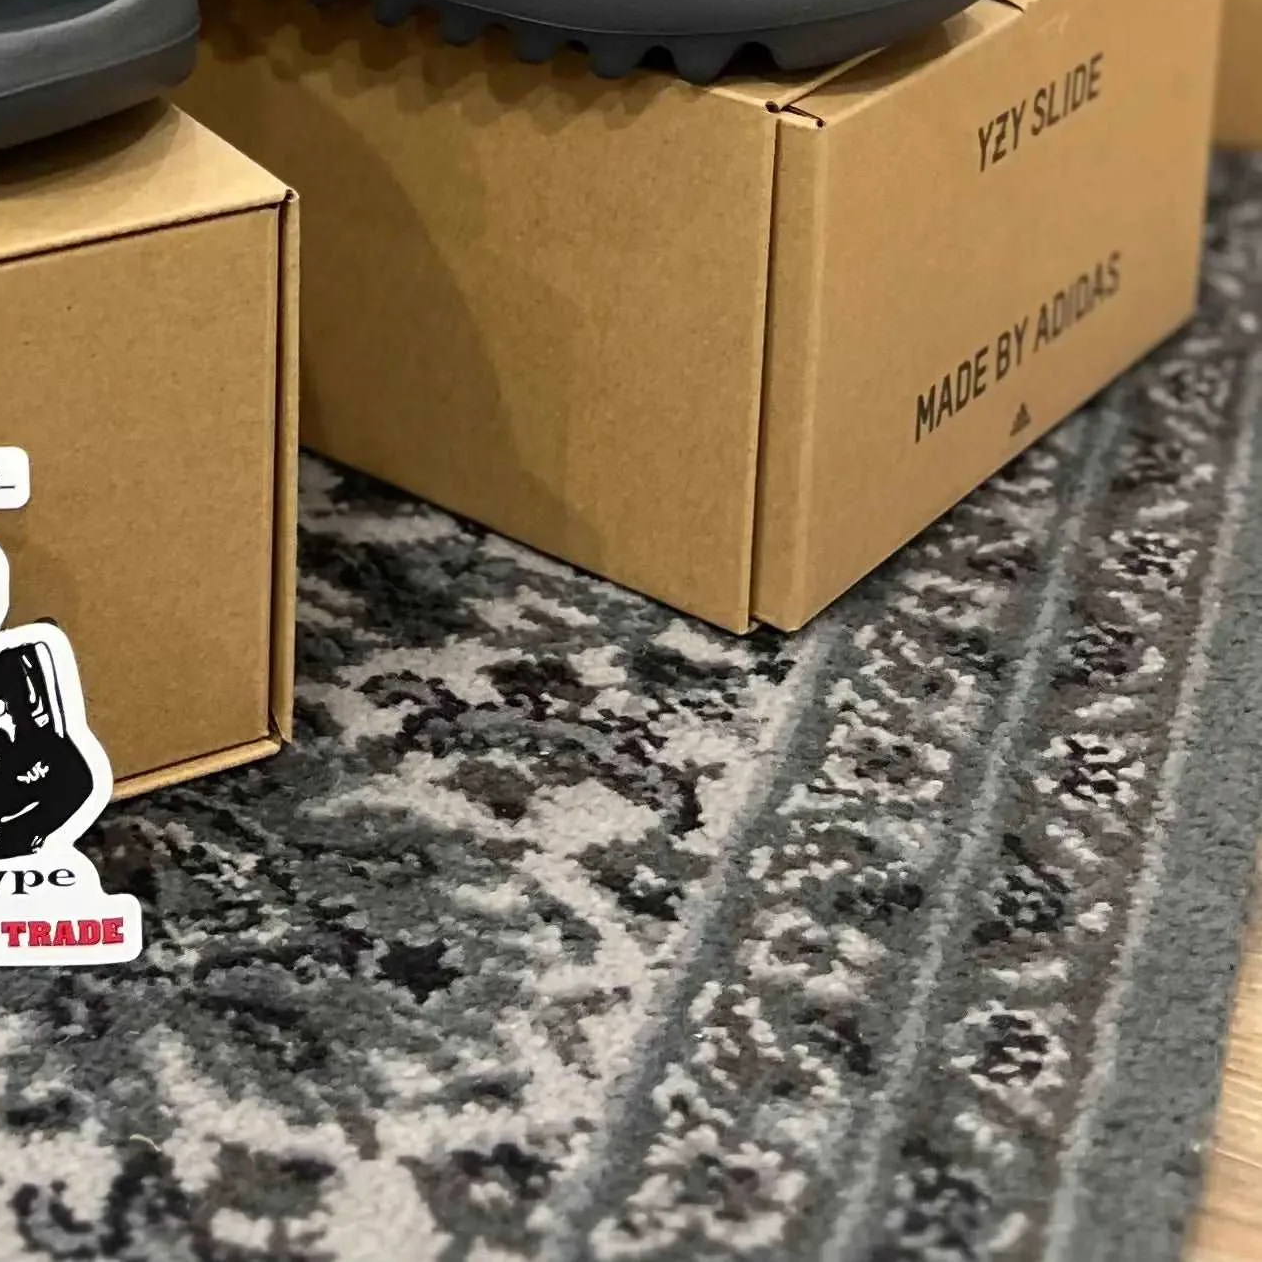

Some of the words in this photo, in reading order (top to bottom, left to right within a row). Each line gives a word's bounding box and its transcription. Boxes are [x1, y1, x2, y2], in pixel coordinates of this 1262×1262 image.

[977, 99, 1027, 173] YZY
[1031, 51, 1104, 136] SLIDE
[915, 346, 989, 444] MADE
[996, 315, 1028, 382] BY
[1033, 250, 1121, 353] ADIDAS
[1, 917, 124, 948] TRADE
